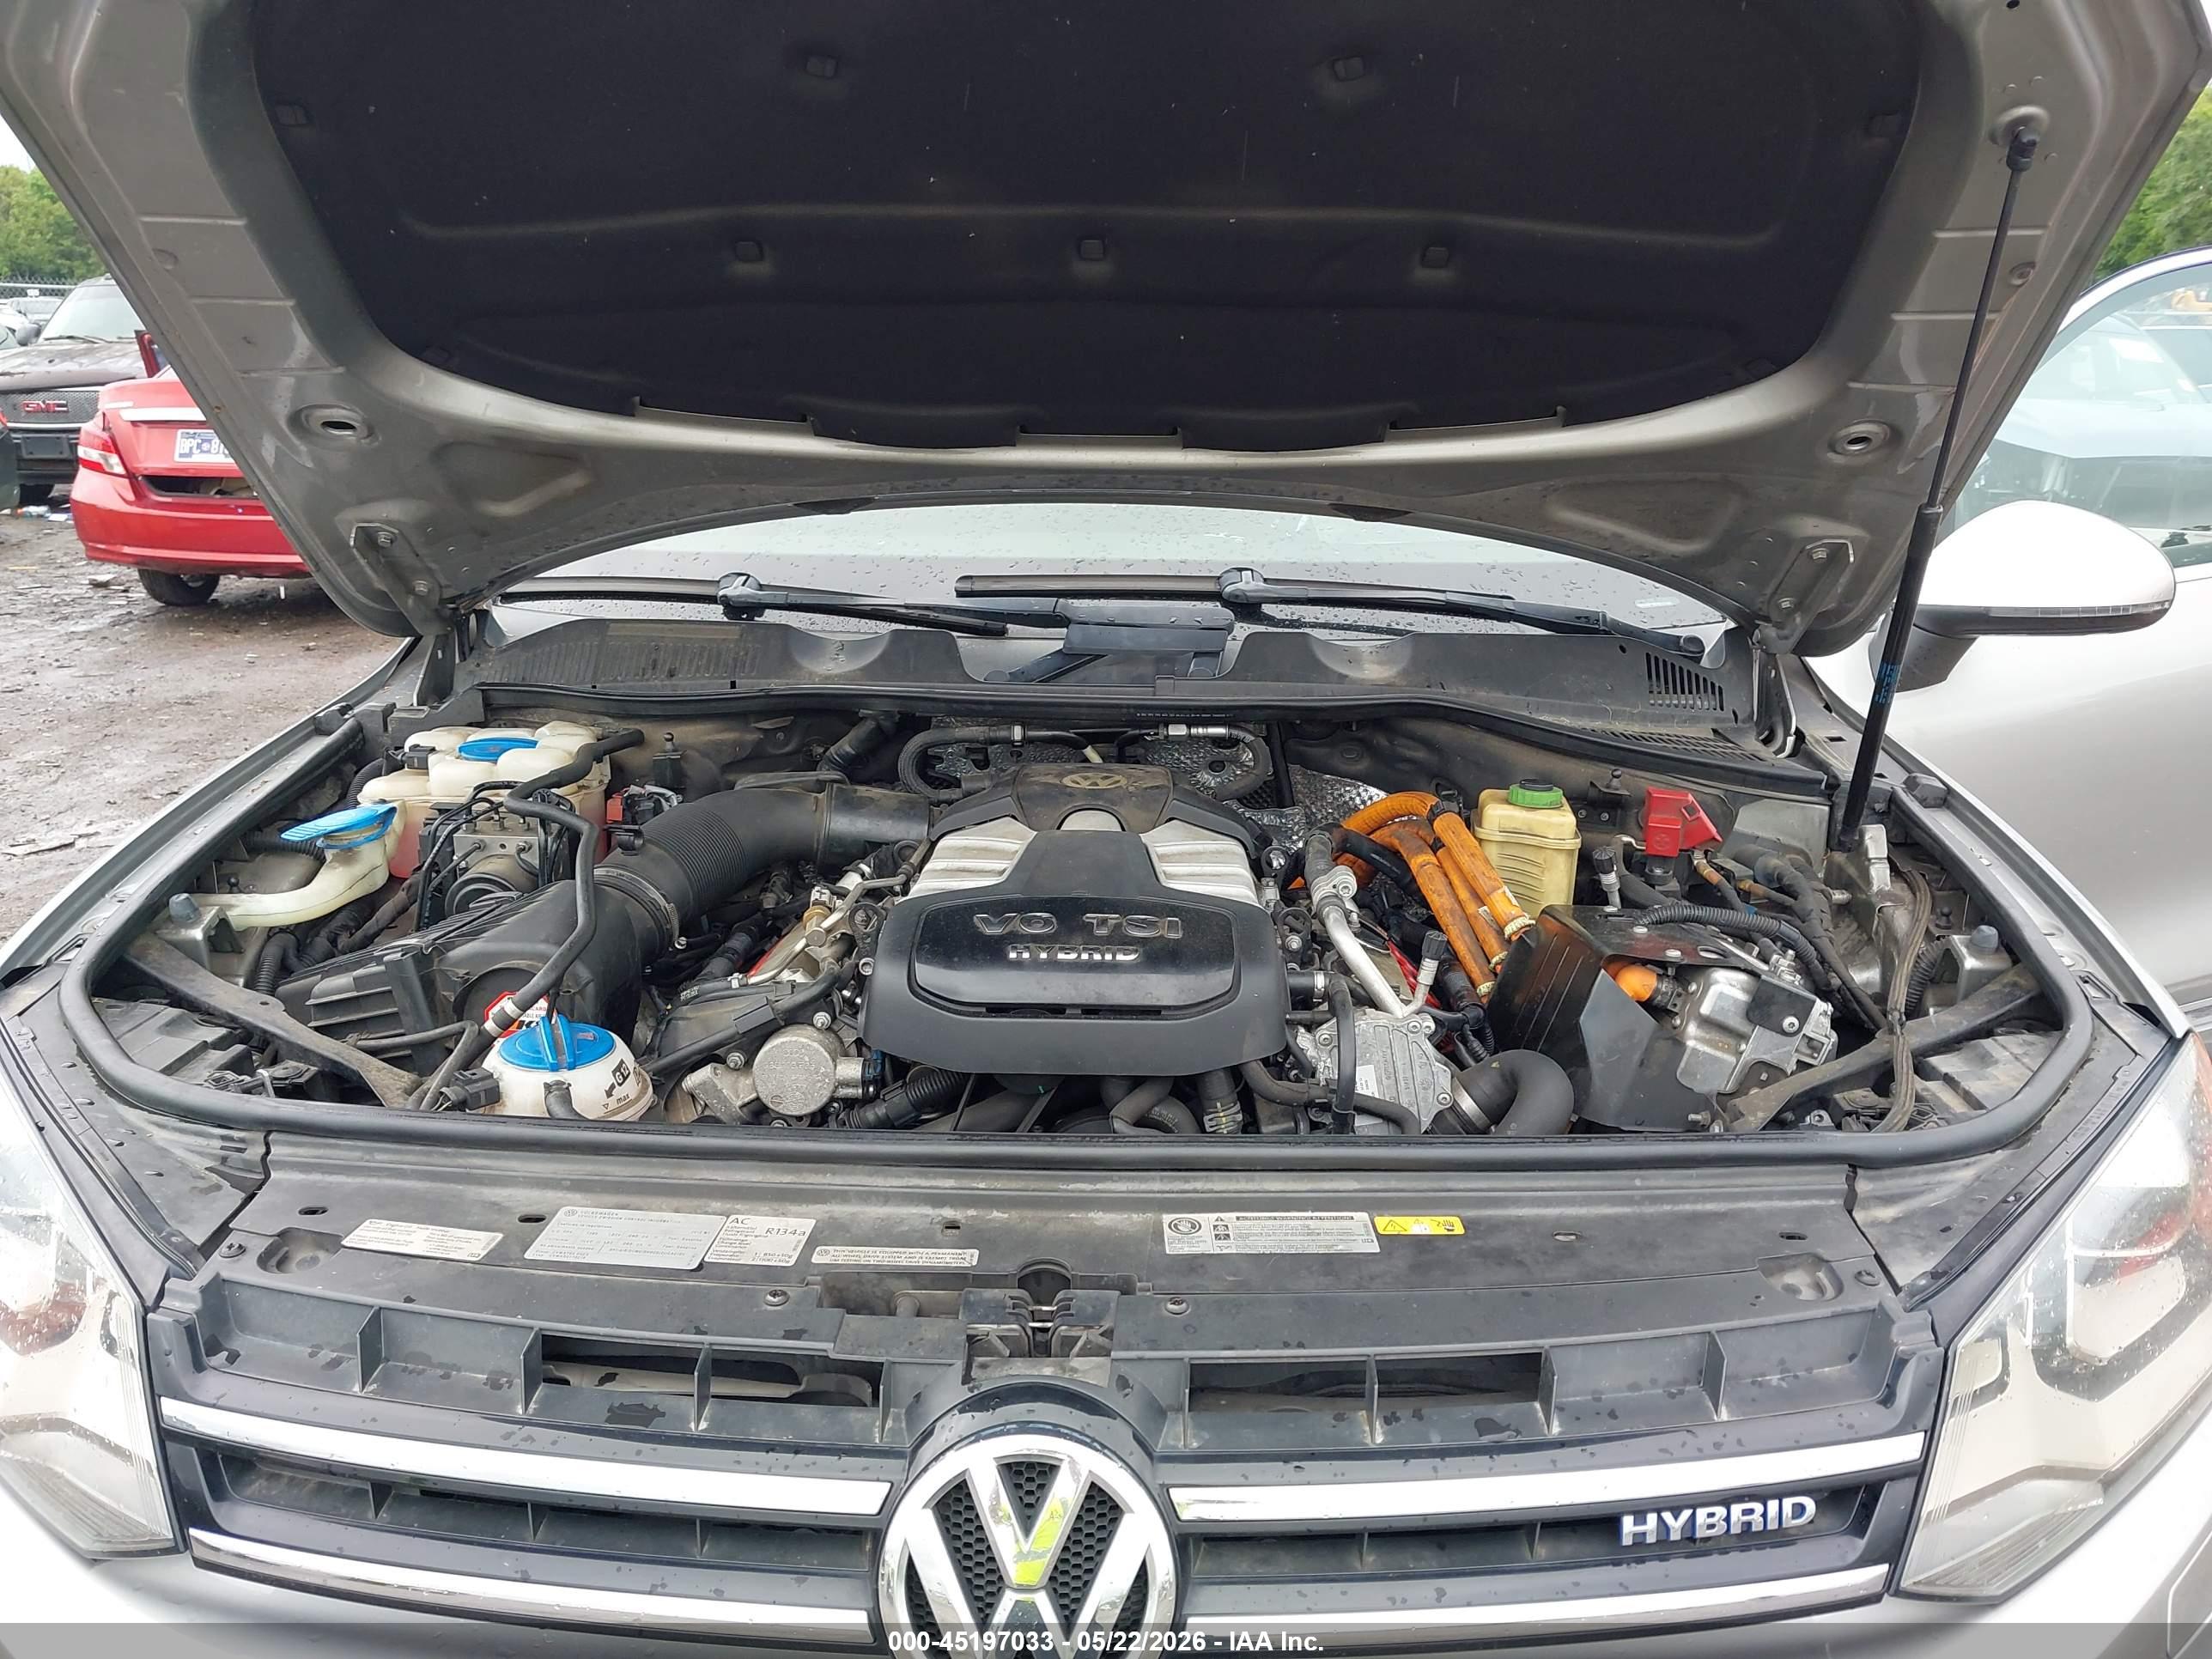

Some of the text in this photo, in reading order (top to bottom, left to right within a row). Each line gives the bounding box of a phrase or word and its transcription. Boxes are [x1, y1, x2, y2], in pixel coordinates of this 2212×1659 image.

[22, 399, 69, 413] GMC
[974, 913, 1182, 939] V6 TSI
[1007, 945, 1140, 960] HYBRID
[614, 1062, 629, 1084] G12
[616, 1093, 630, 1105] max
[729, 1217, 751, 1225] AC
[764, 1227, 806, 1237] R134a
[1620, 1496, 1817, 1546] HYBRID
